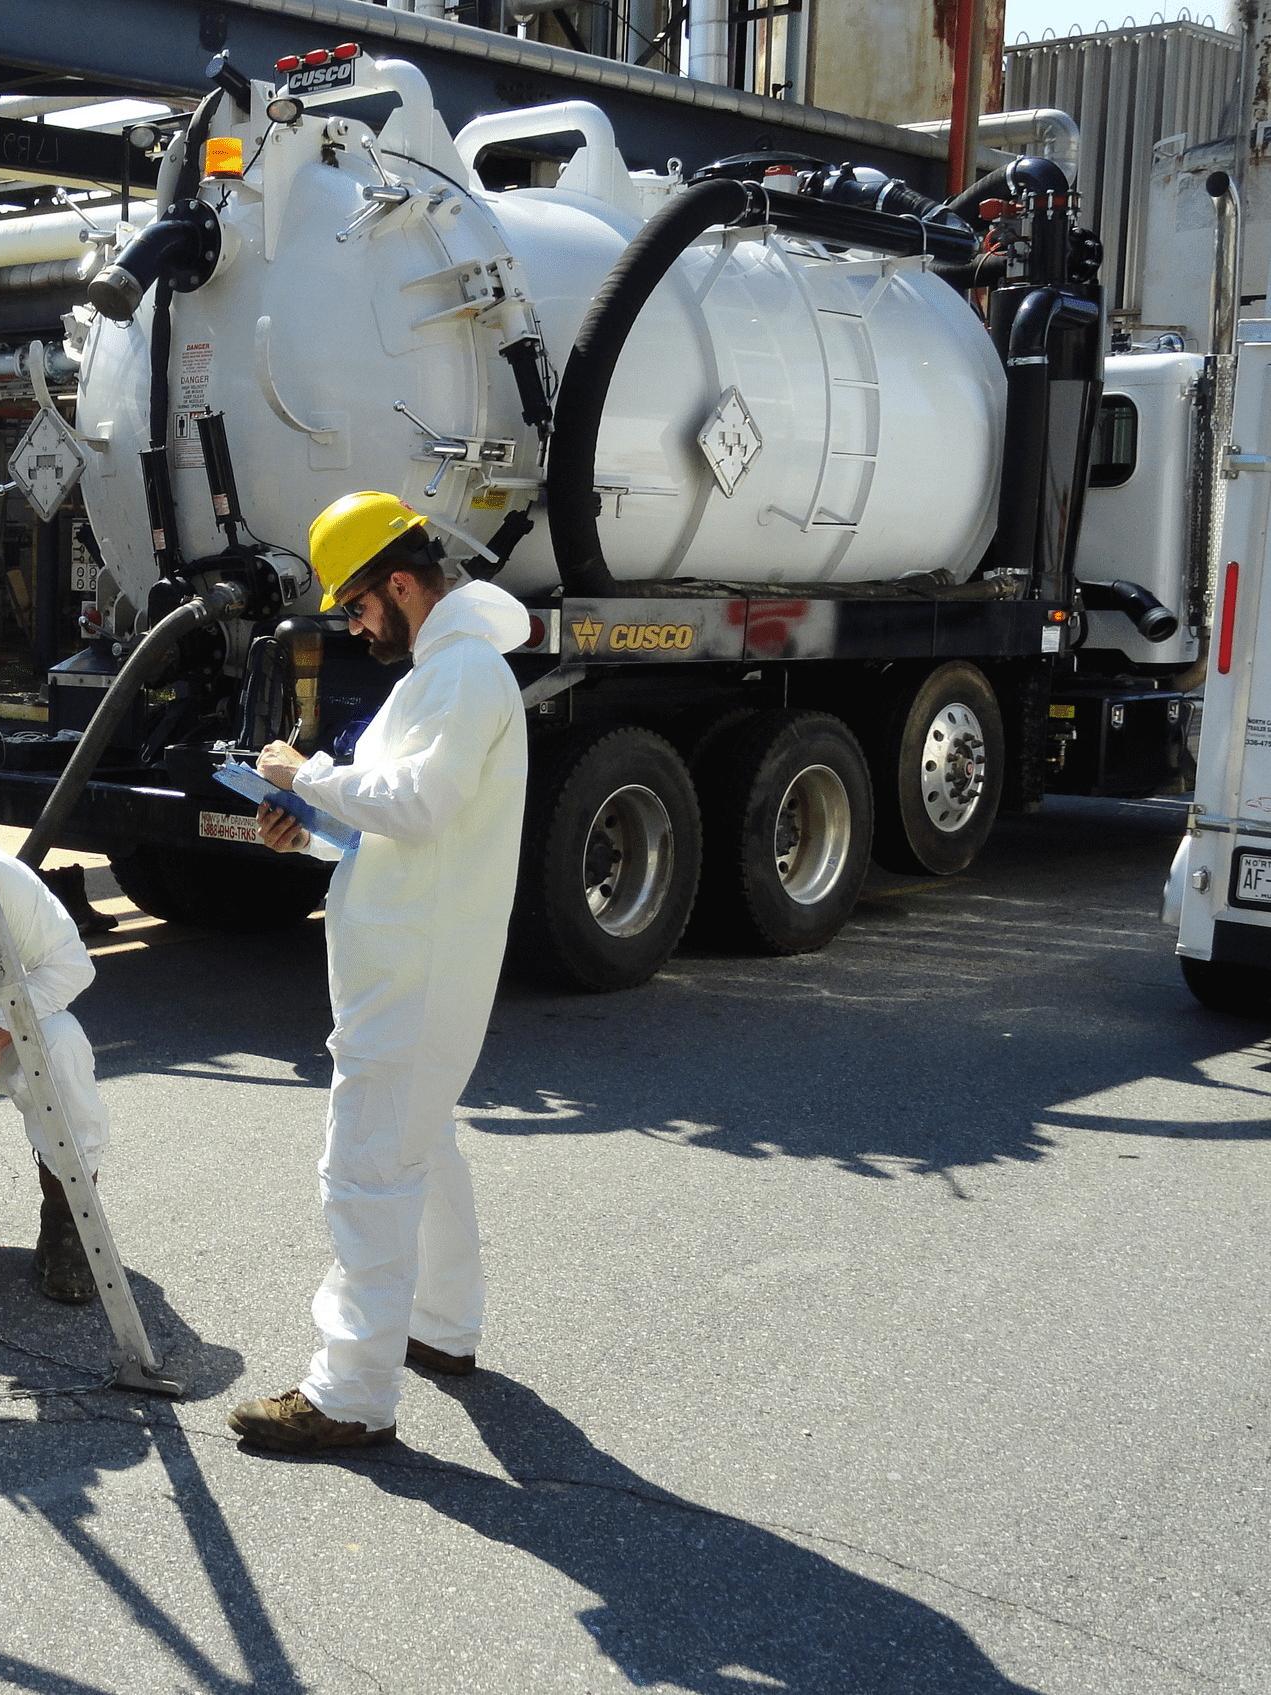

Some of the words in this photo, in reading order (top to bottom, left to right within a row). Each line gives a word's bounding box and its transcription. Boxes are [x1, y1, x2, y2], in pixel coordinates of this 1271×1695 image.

[289, 63, 351, 89] CUSCO
[186, 343, 210, 351] DANGER
[180, 375, 209, 384] DANGER
[609, 623, 694, 651] CUSCO
